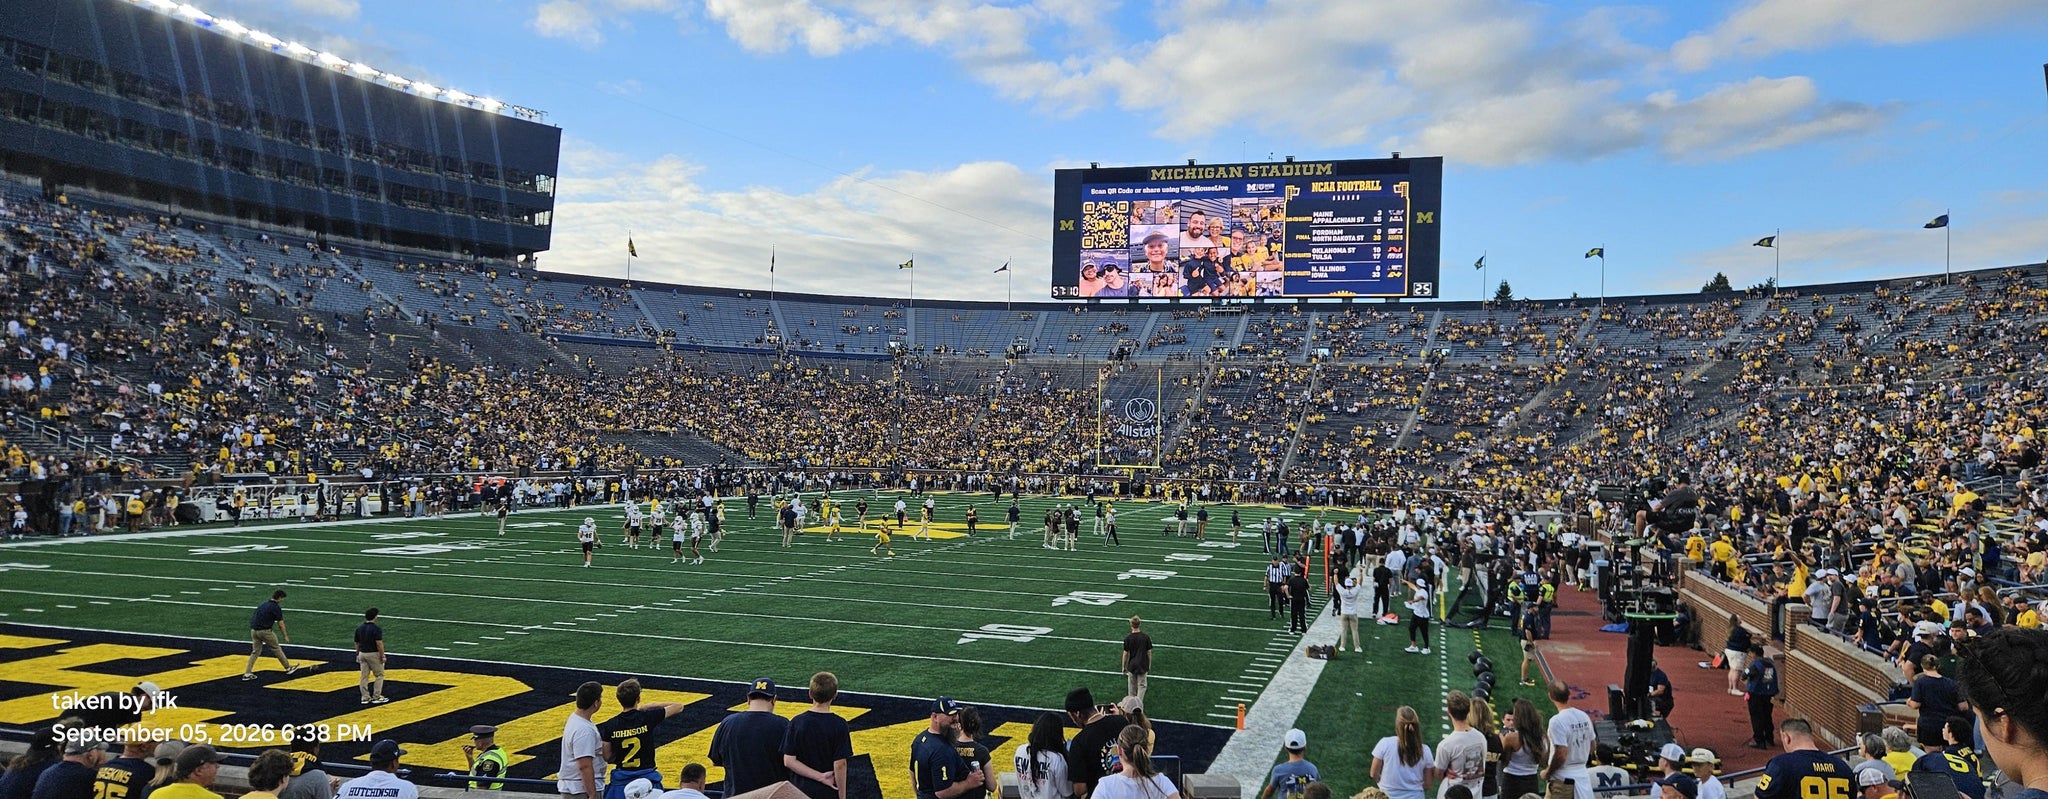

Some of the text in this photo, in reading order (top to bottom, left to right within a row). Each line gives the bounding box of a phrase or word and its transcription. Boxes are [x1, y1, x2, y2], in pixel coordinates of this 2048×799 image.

[1150, 163, 1332, 180] MICHIGAN STADIUM
[1312, 180, 1382, 192] NCAA FOOTBALL
[1416, 212, 1433, 223] M
[1060, 220, 1074, 230] M
[1100, 220, 1112, 230] M
[1414, 284, 1430, 294] 25
[1117, 424, 1162, 438] Allstate
[1055, 590, 1128, 606] 20
[958, 624, 1054, 643] 10
[611, 725, 648, 738] JOHNSON
[622, 737, 641, 767] 2
[941, 766, 948, 780] 1
[1812, 762, 1835, 773] MARR
[1597, 772, 1622, 788] M
[348, 787, 400, 798] HUTCHINSON
